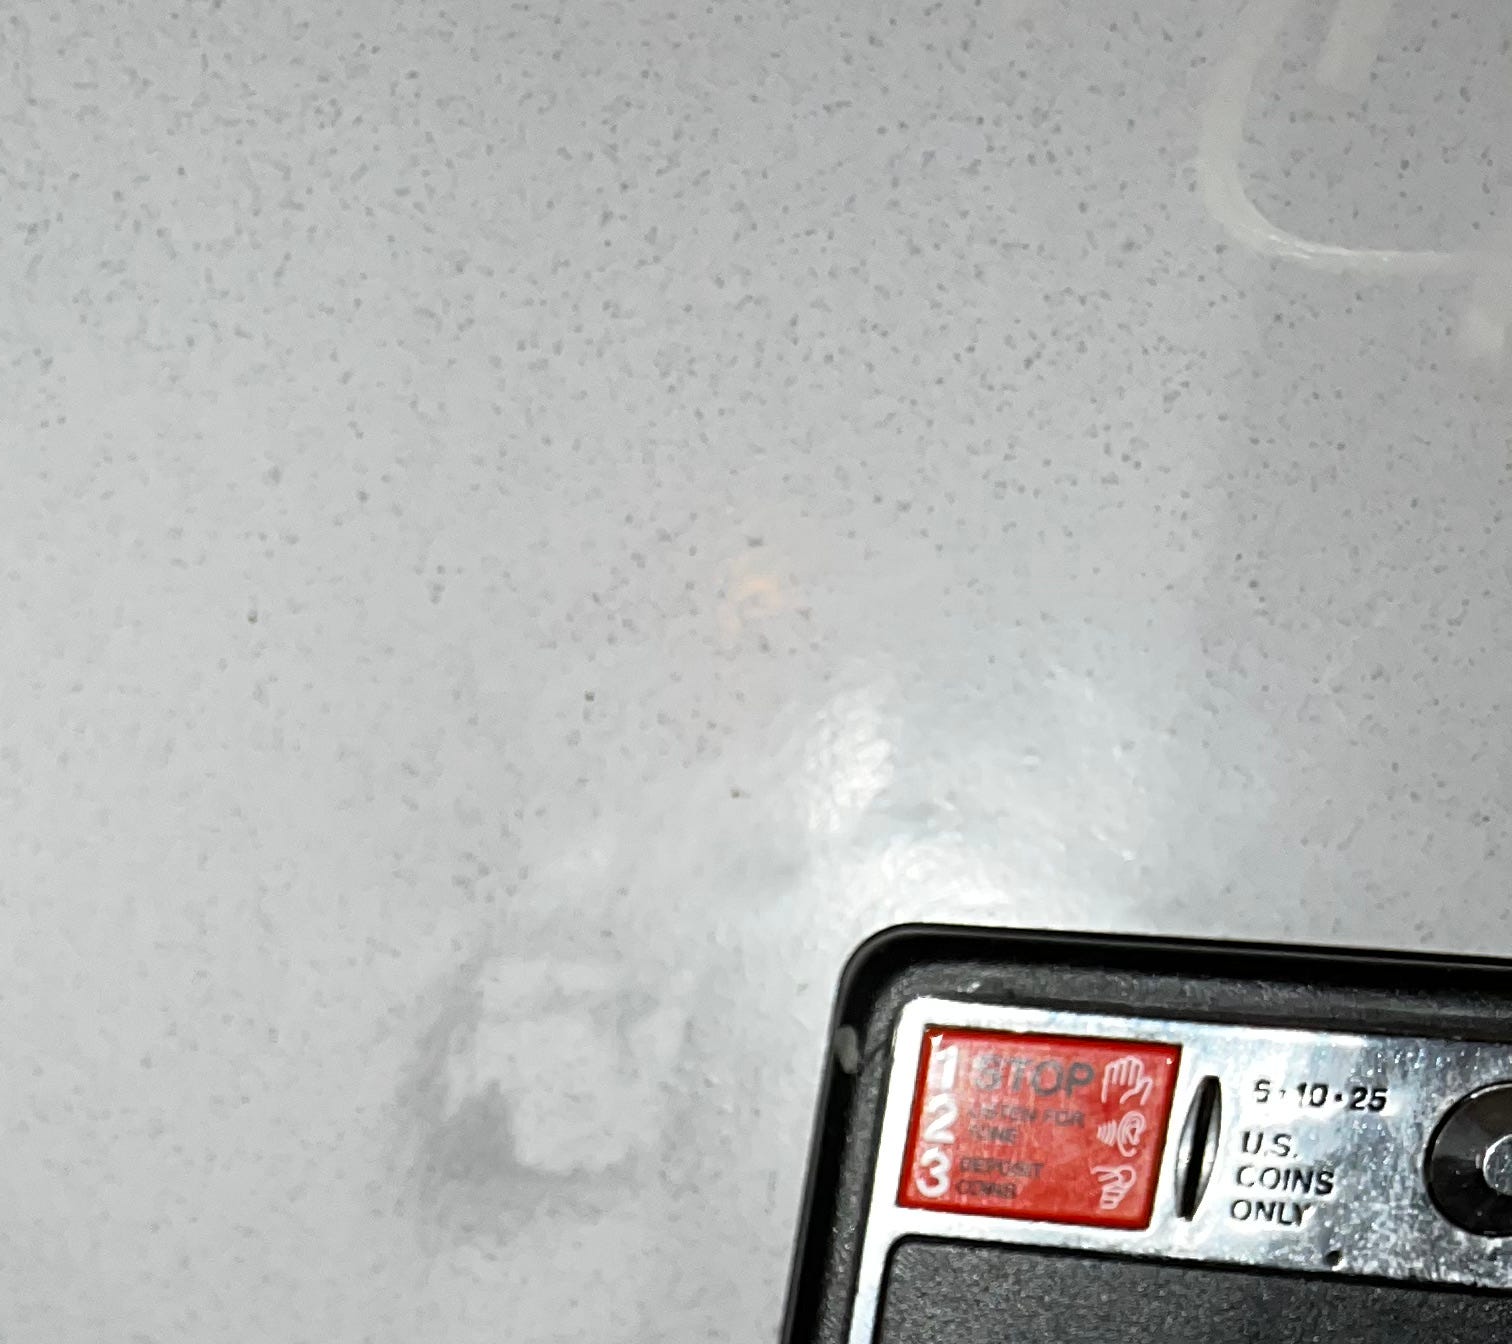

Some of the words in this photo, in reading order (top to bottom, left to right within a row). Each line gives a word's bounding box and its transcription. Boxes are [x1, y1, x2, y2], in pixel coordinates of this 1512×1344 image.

[930, 1043, 958, 1089] 1
[972, 1053, 1095, 1098] STOP
[923, 1094, 958, 1144] 2
[1042, 1110, 1085, 1128] FOR
[1242, 1131, 1298, 1158] U.S.
[916, 1149, 950, 1197] 3
[959, 1158, 1044, 1180] DEPOSIT
[1236, 1165, 1335, 1195] COINS
[1230, 1200, 1312, 1226] ONLY
